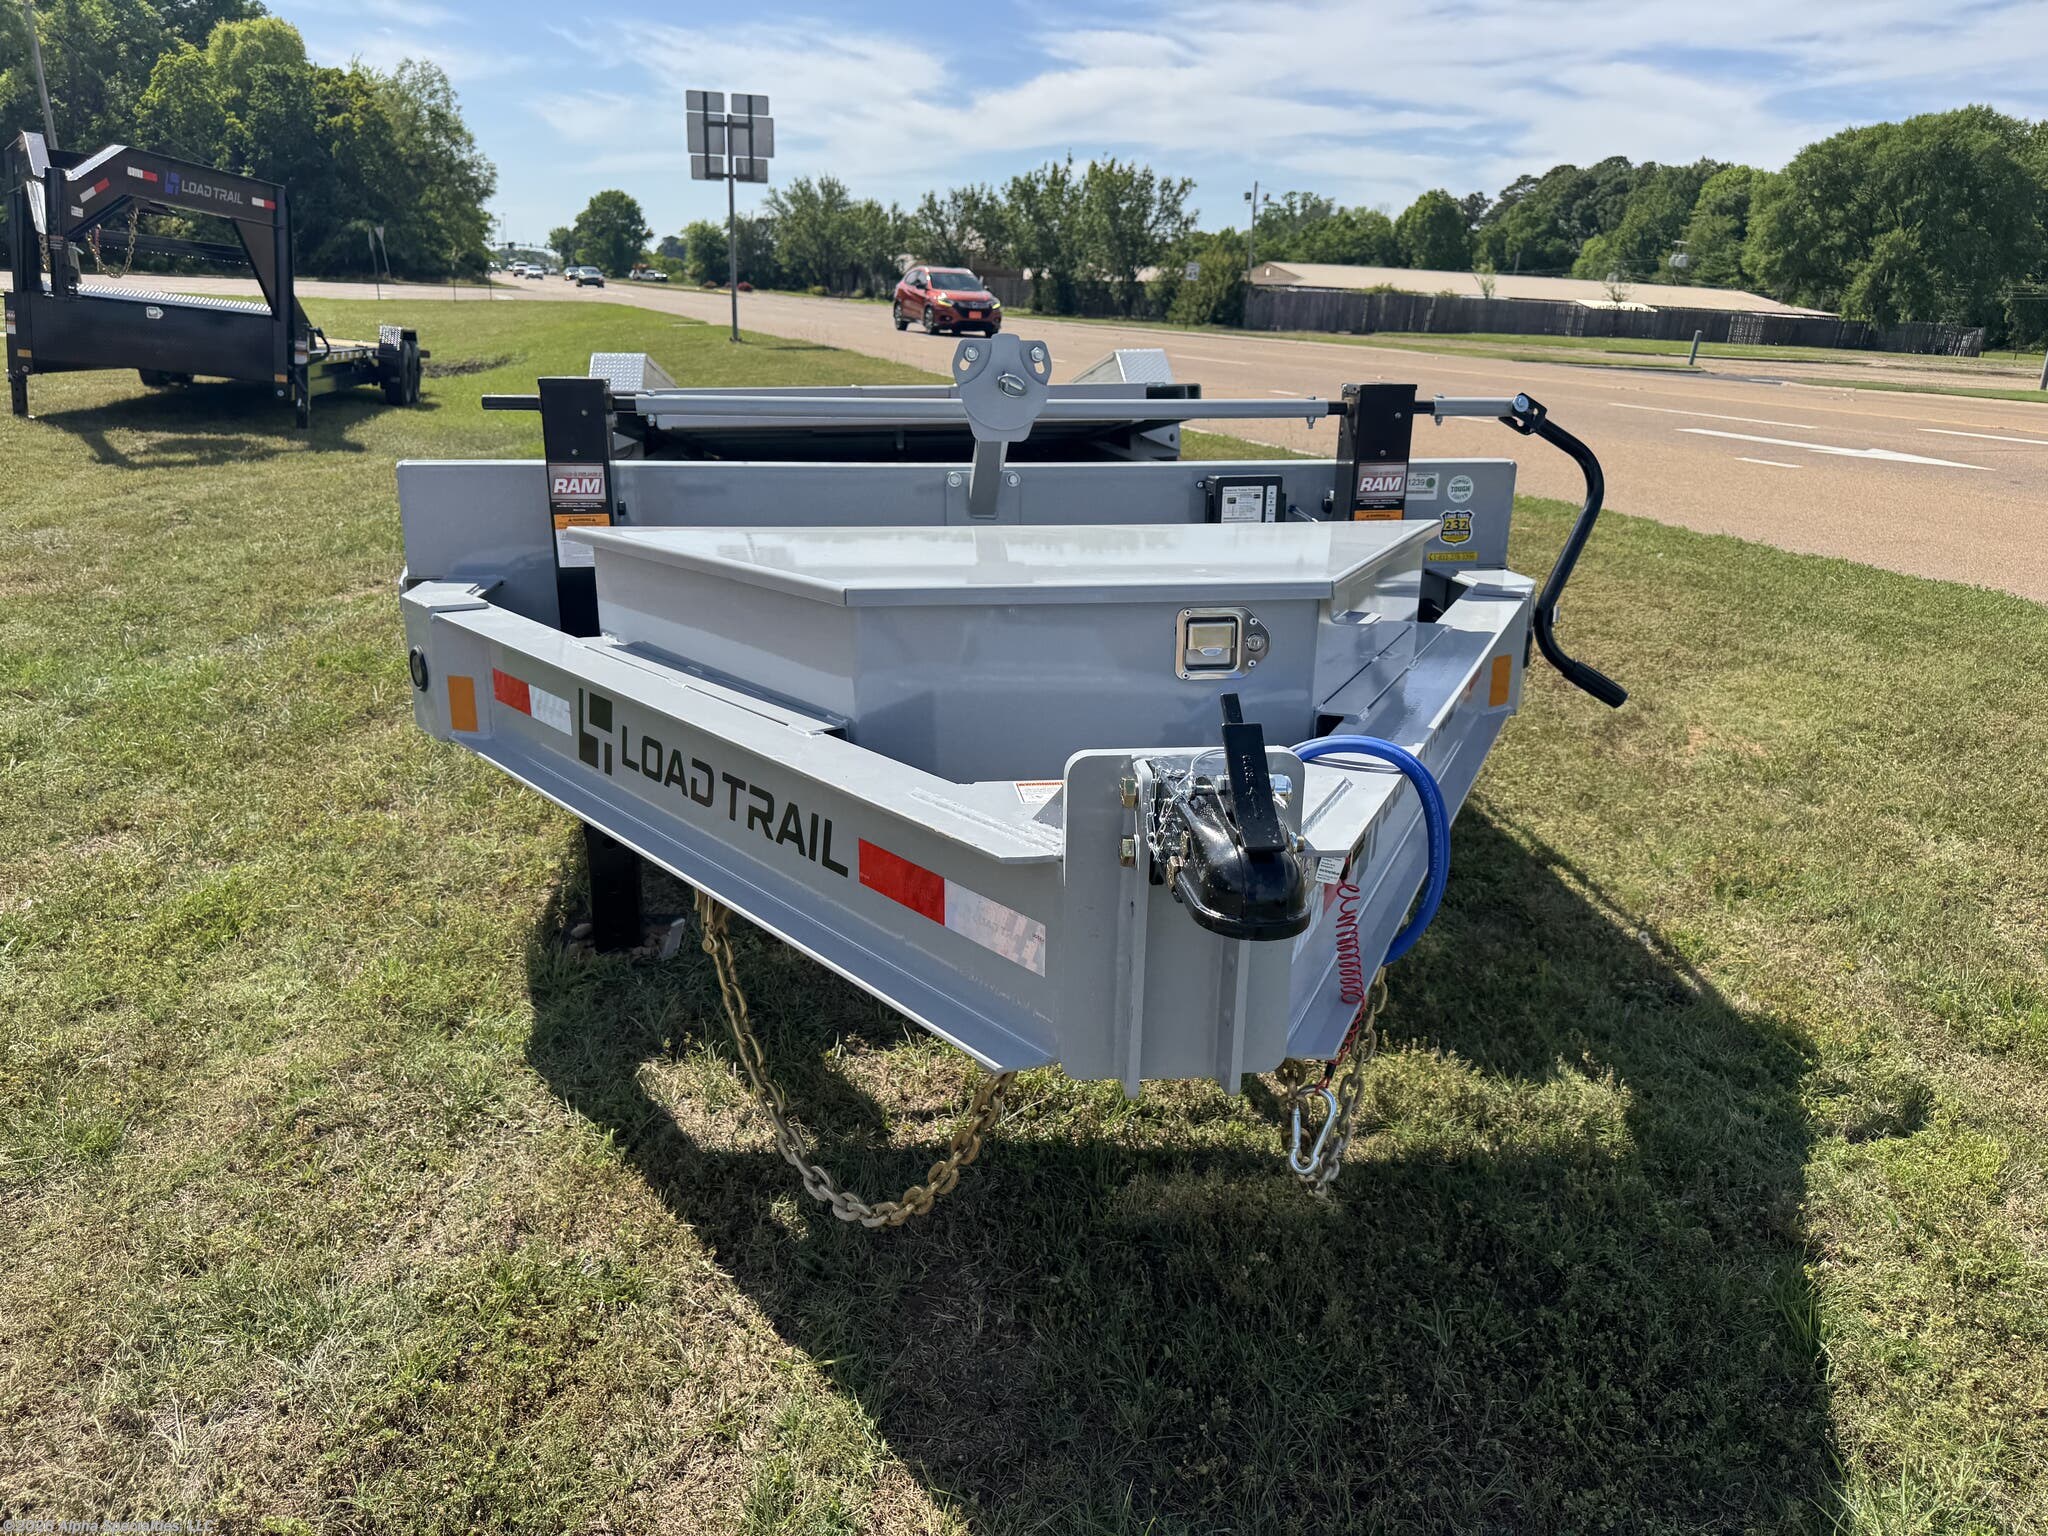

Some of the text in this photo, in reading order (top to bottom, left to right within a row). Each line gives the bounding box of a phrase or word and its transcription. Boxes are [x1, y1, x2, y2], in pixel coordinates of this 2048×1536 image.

[181, 180, 244, 205] LOAD TRAIL
[553, 478, 602, 494] RAM
[1360, 477, 1403, 491] RAM
[1445, 519, 1468, 530] 232
[622, 725, 849, 878] LOAD TRAIL
